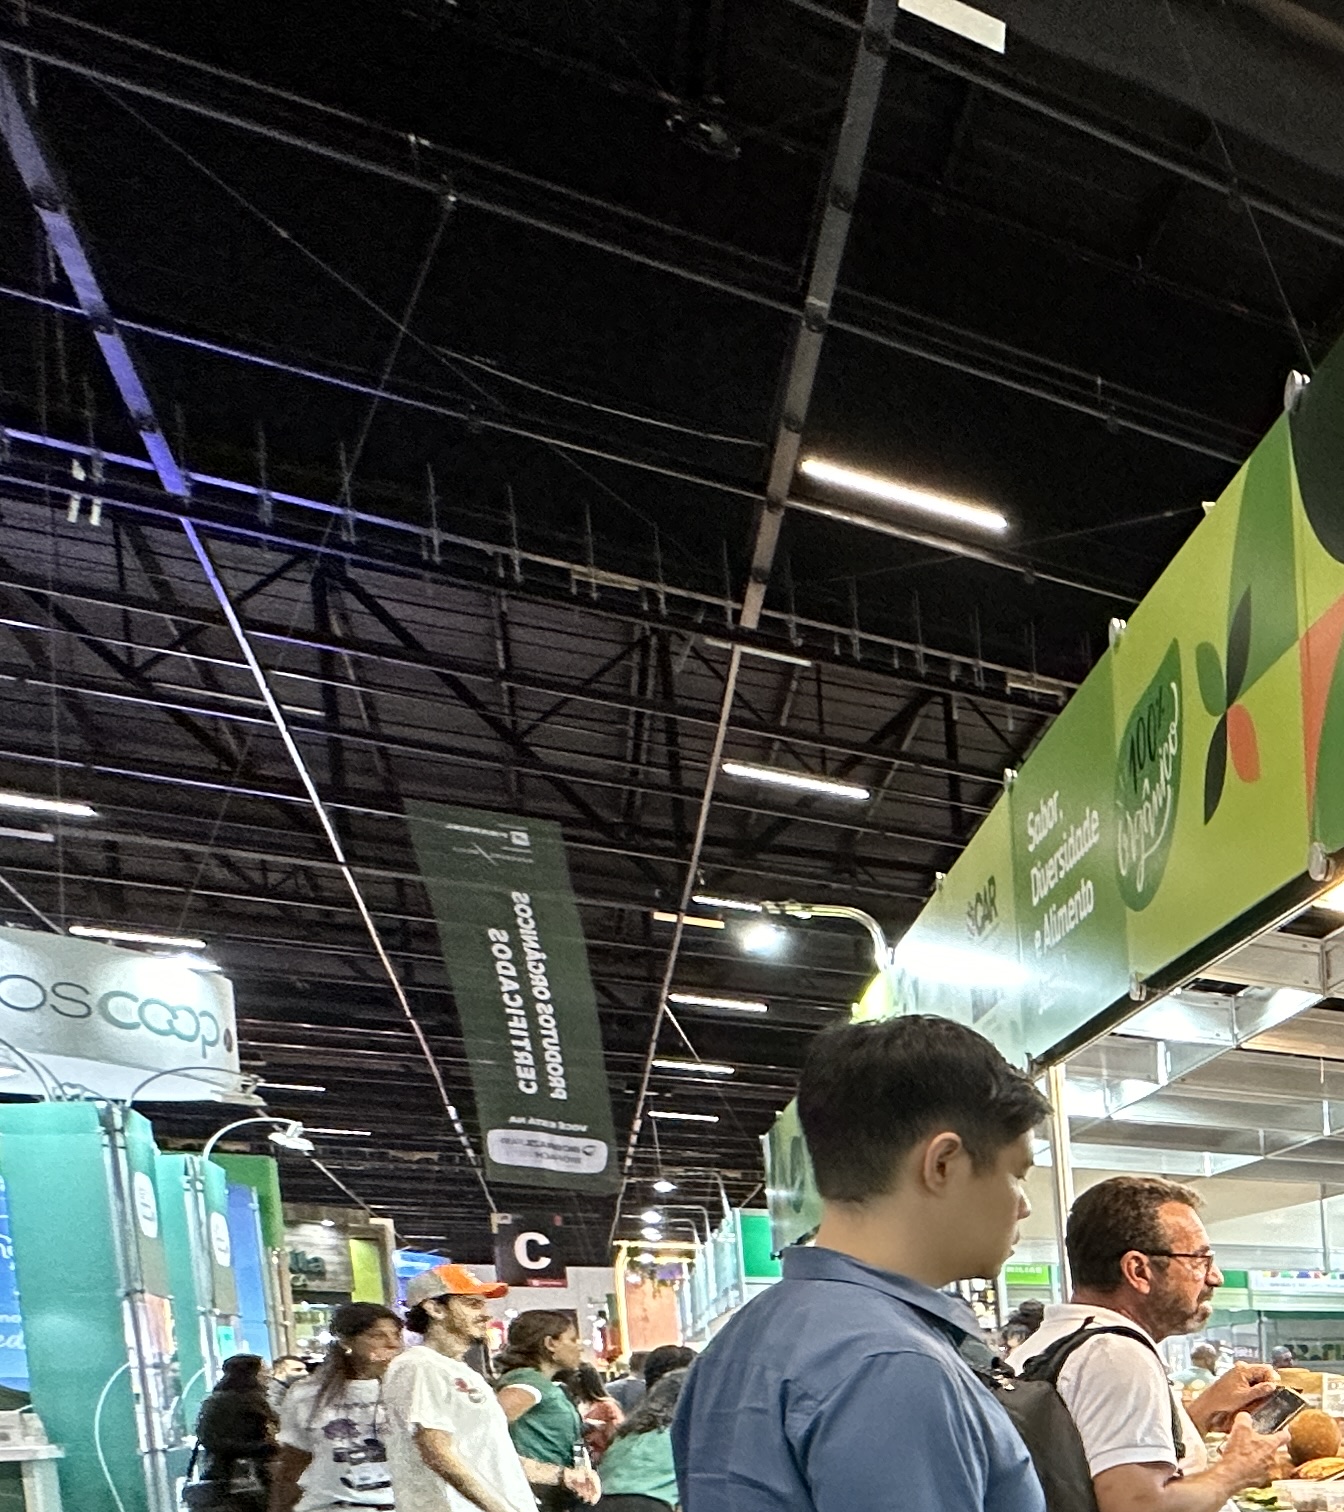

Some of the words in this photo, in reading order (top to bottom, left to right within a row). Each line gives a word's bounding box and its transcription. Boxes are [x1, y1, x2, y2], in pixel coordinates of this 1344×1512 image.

[1027, 790, 1063, 852] Sabor,
[1029, 807, 1099, 907] Diversidade
[1034, 929, 1042, 959] e
[1043, 878, 1095, 951] Alimento
[514, 1231, 552, 1270] C
